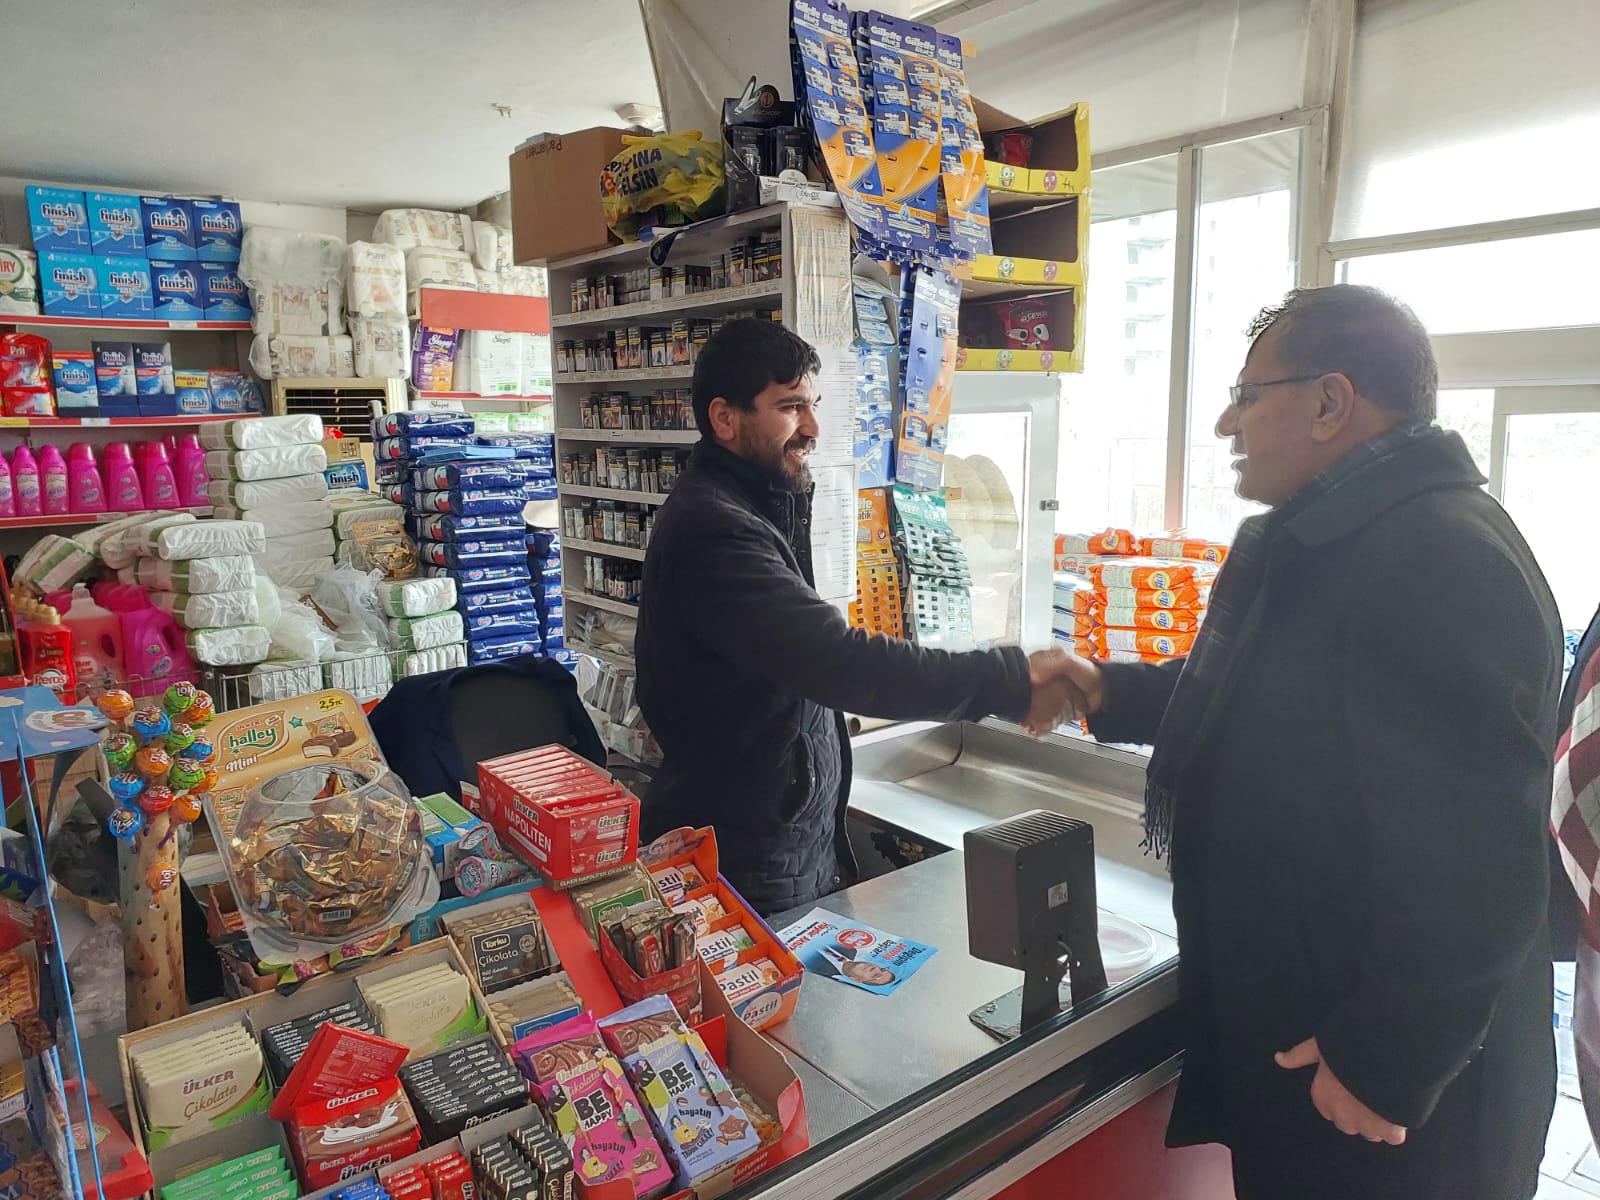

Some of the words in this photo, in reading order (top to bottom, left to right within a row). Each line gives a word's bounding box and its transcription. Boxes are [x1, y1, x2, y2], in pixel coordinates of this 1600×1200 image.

[870, 26, 902, 42] Gillette
[905, 35, 935, 51] Gillette
[42, 203, 76, 219] finish
[100, 208, 132, 224] finish
[151, 213, 187, 229] finish
[201, 216, 236, 232] finish
[0, 259, 16, 273] IRY
[53, 268, 88, 284] finish
[109, 271, 141, 287] finish
[159, 275, 194, 292] finish
[209, 276, 243, 292] finish
[62, 368, 91, 382] finish
[181, 396, 208, 409] finish
[329, 471, 359, 487] finish
[1153, 572, 1165, 589] ALO
[1158, 591, 1170, 607] ALO
[1157, 611, 1168, 628] ALO
[1158, 639, 1170, 654] ALO
[228, 726, 277, 751] halley
[226, 754, 259, 773] Mini
[513, 796, 539, 825] ÜLKER
[657, 872, 682, 888] stil
[484, 936, 507, 949] Torku
[701, 937, 732, 958] astil
[479, 949, 519, 968] Çikolata
[719, 969, 760, 992] Pastil
[742, 999, 778, 1021] Pastil
[183, 1070, 235, 1096] ÜLKER
[658, 1060, 694, 1091] BE
[667, 1078, 698, 1098] HAPPY
[184, 1083, 238, 1122] Çikolata
[326, 1088, 378, 1110] ÜLKER
[573, 1089, 611, 1122] BE
[583, 1109, 613, 1130] HAPPY
[679, 1108, 712, 1121] hayatın
[591, 1142, 626, 1155] hayatın
[339, 1153, 392, 1182] ÜLKER
